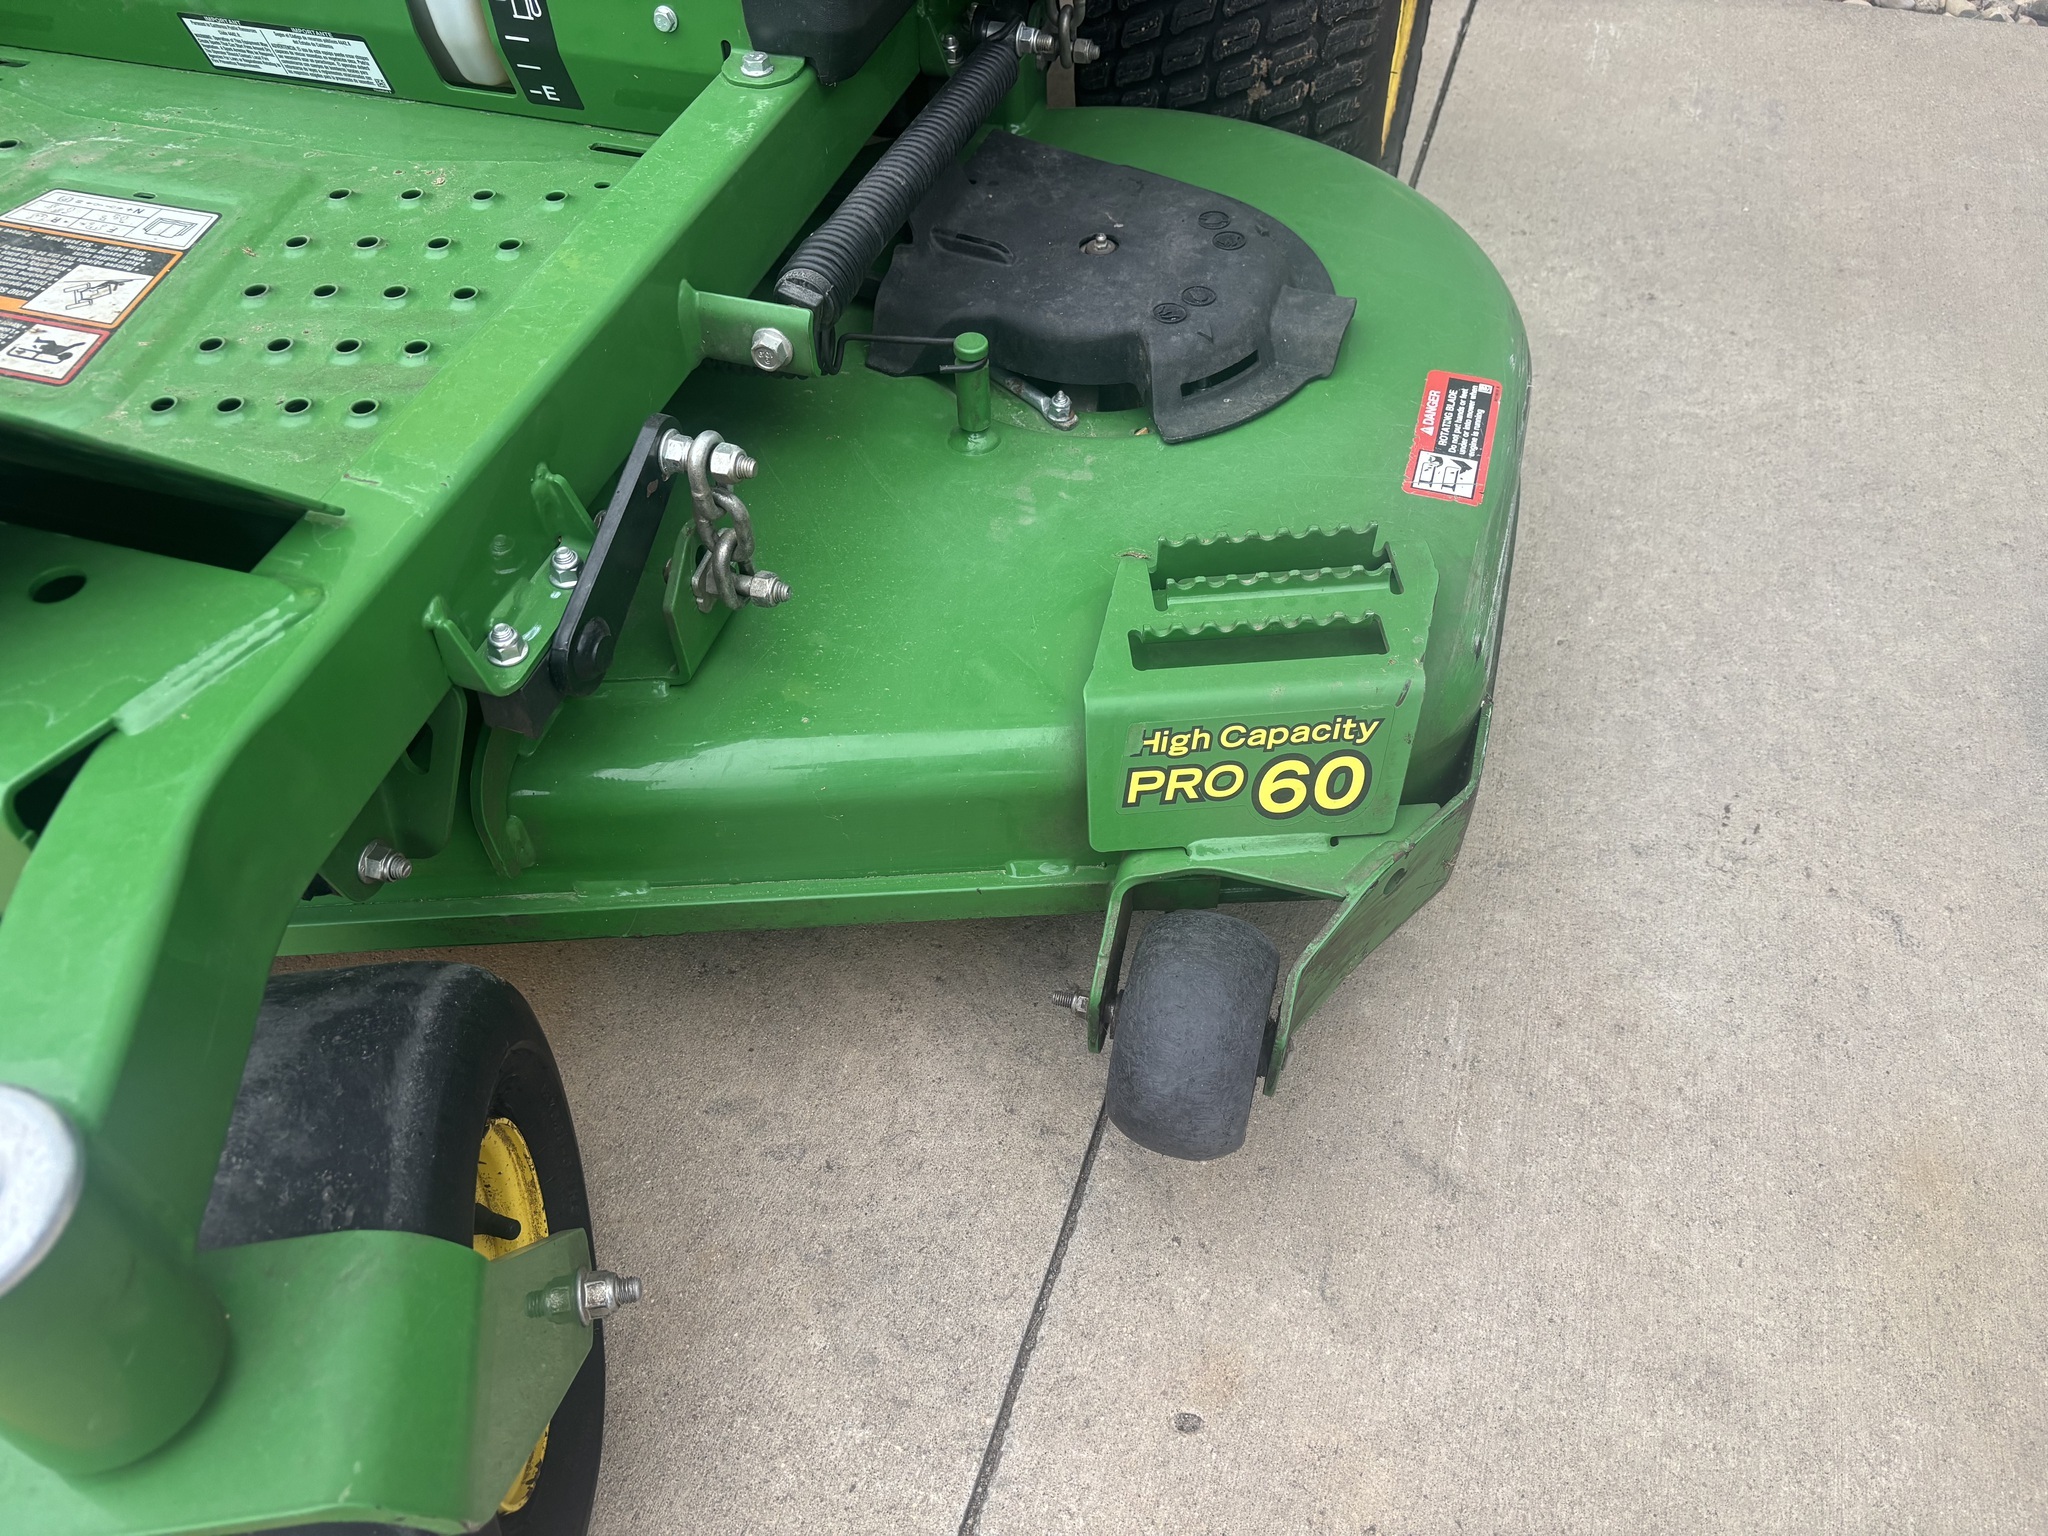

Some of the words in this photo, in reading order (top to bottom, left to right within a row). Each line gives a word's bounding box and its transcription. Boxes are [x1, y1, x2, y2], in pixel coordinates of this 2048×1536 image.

[203, 16, 240, 26] IMPORTANT
[291, 27, 333, 38] IMPORTANTE
[542, 85, 560, 101] E
[97, 249, 125, 258] leaving
[103, 245, 129, 253] engine
[77, 257, 104, 266] objects
[92, 254, 119, 262] sudden
[104, 262, 135, 271] Remove
[7, 288, 35, 297] AVOID
[1460, 388, 1469, 399] feet
[1469, 385, 1479, 400] when
[1446, 389, 1458, 412] BLADE
[1459, 398, 1466, 406] or
[1426, 390, 1441, 426] DANGER
[1454, 405, 1465, 423] hands
[1466, 399, 1476, 418] mower
[1463, 418, 1472, 430] into
[1474, 408, 1486, 431] running
[1438, 410, 1455, 446] ROTATING
[1453, 422, 1463, 434] put
[1471, 429, 1479, 437] is
[1452, 434, 1460, 444] not
[1448, 443, 1456, 453] Do
[1459, 437, 1468, 455] under
[1468, 437, 1480, 458] engine
[1130, 726, 1211, 757] High
[1218, 716, 1383, 752] Capacity
[1123, 761, 1247, 807] PRO
[1252, 750, 1371, 819] 60
